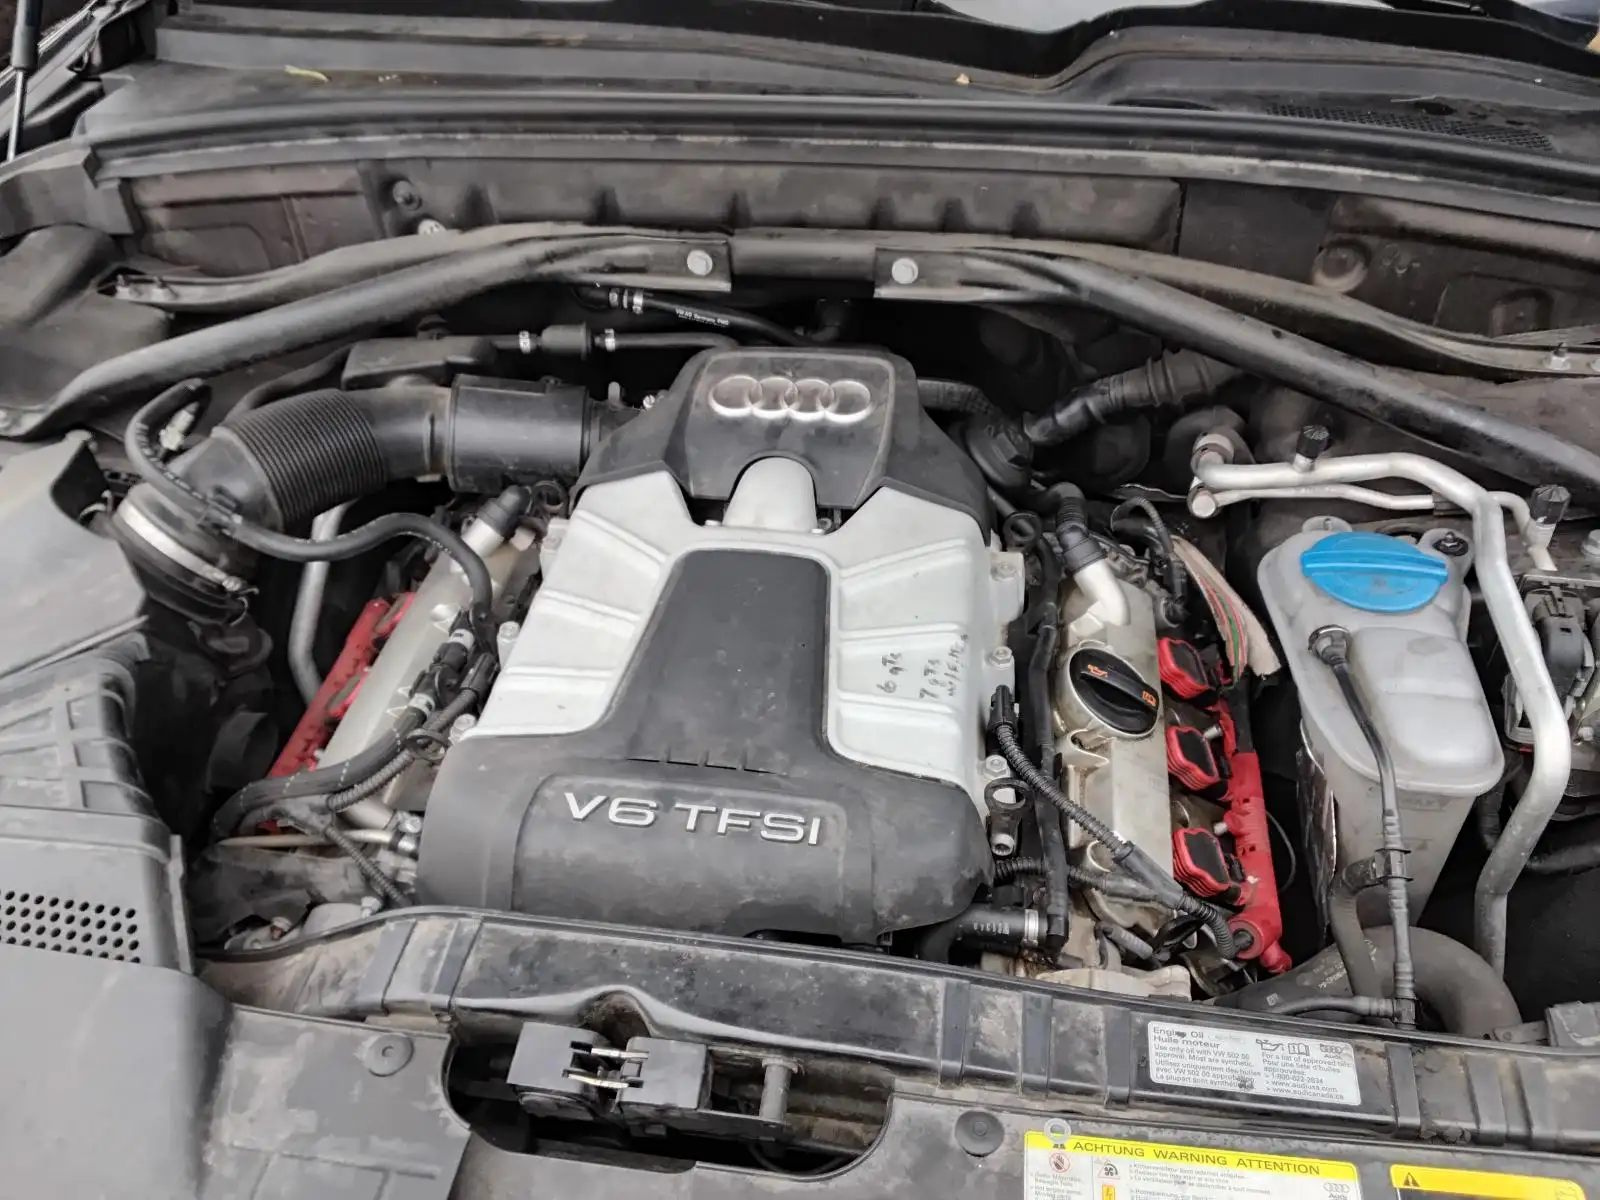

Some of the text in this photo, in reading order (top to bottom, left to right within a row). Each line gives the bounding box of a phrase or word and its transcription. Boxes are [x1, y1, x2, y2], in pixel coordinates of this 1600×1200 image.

[563, 791, 822, 847] V6 TFSI
[1154, 1035, 1179, 1044] Huile
[1182, 1039, 1221, 1049] moteur
[1190, 1031, 1204, 1039] Oil
[1169, 1045, 1184, 1054] only
[1073, 1141, 1145, 1158] ACHTUNG
[1153, 1149, 1228, 1168] WARNING
[1236, 1157, 1321, 1176] ATTENTION
